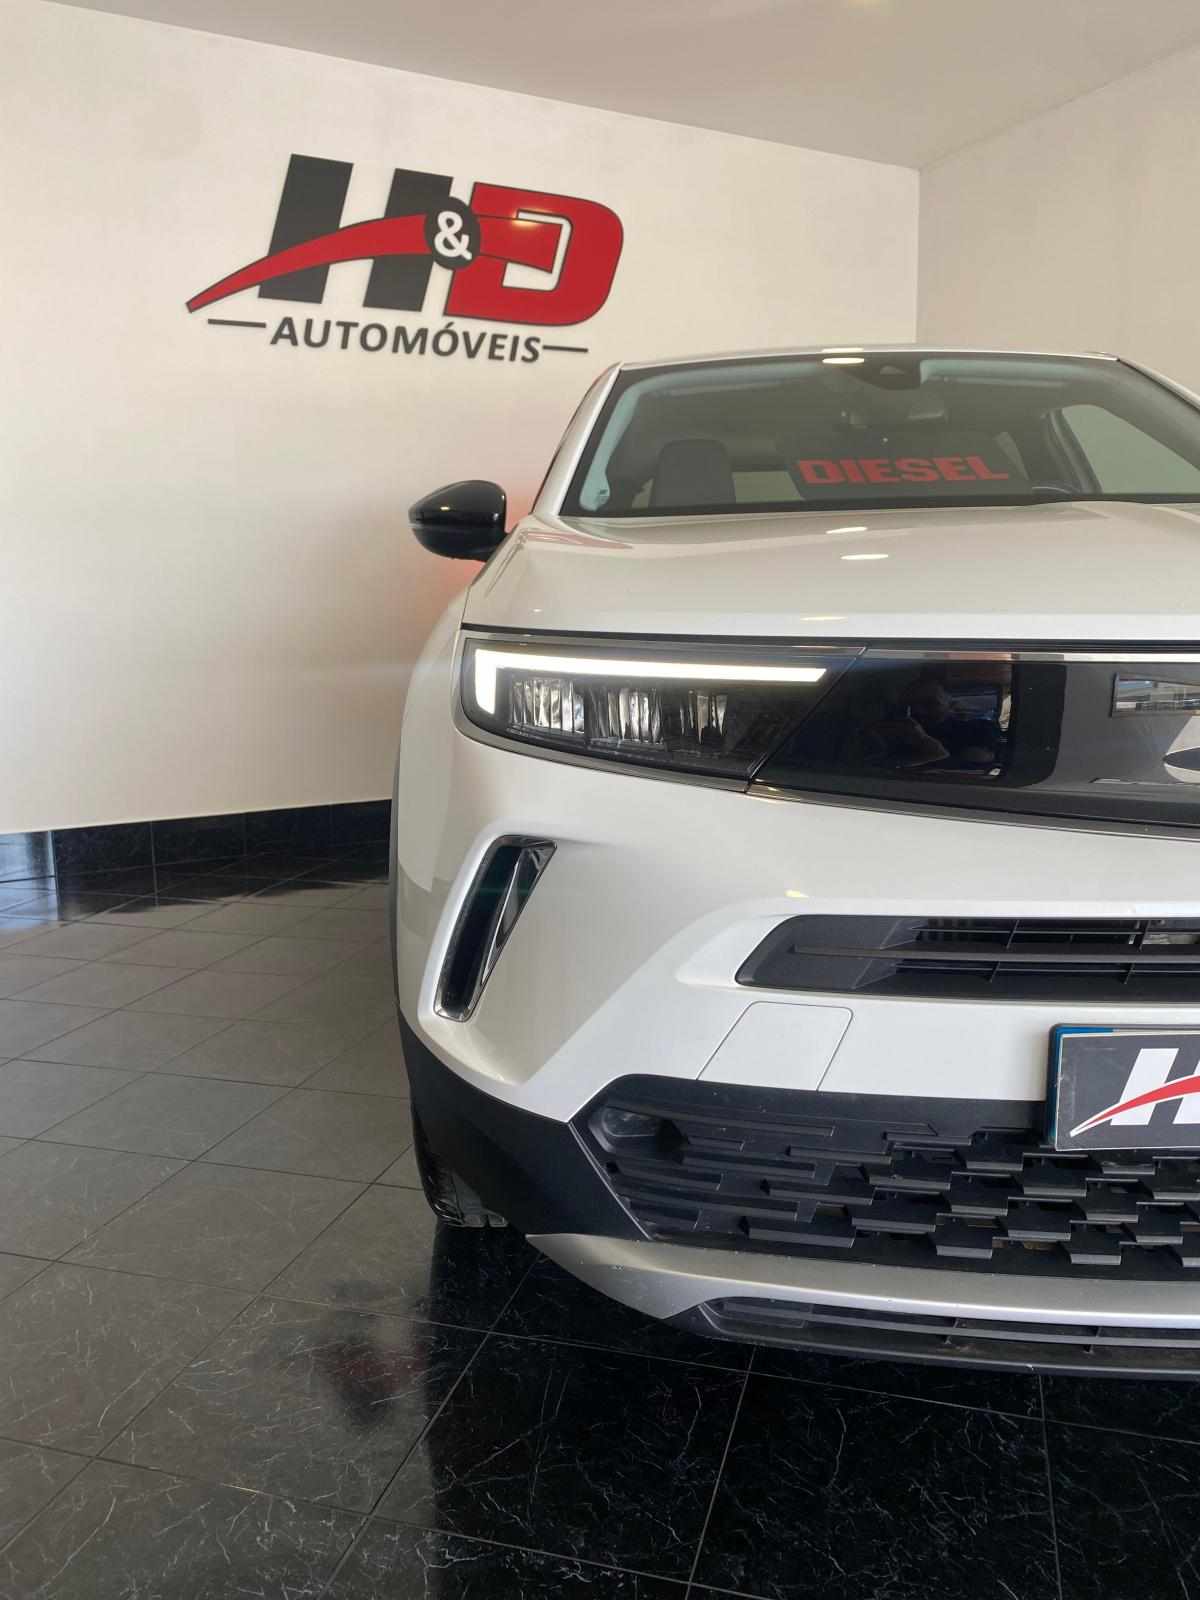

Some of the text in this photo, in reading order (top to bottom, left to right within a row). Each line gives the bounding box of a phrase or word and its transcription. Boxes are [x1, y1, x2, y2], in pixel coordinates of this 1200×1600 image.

[258, 154, 624, 326] H&D
[270, 316, 541, 363] AUTOMÓVEIS
[798, 456, 1009, 484] DIESEL
